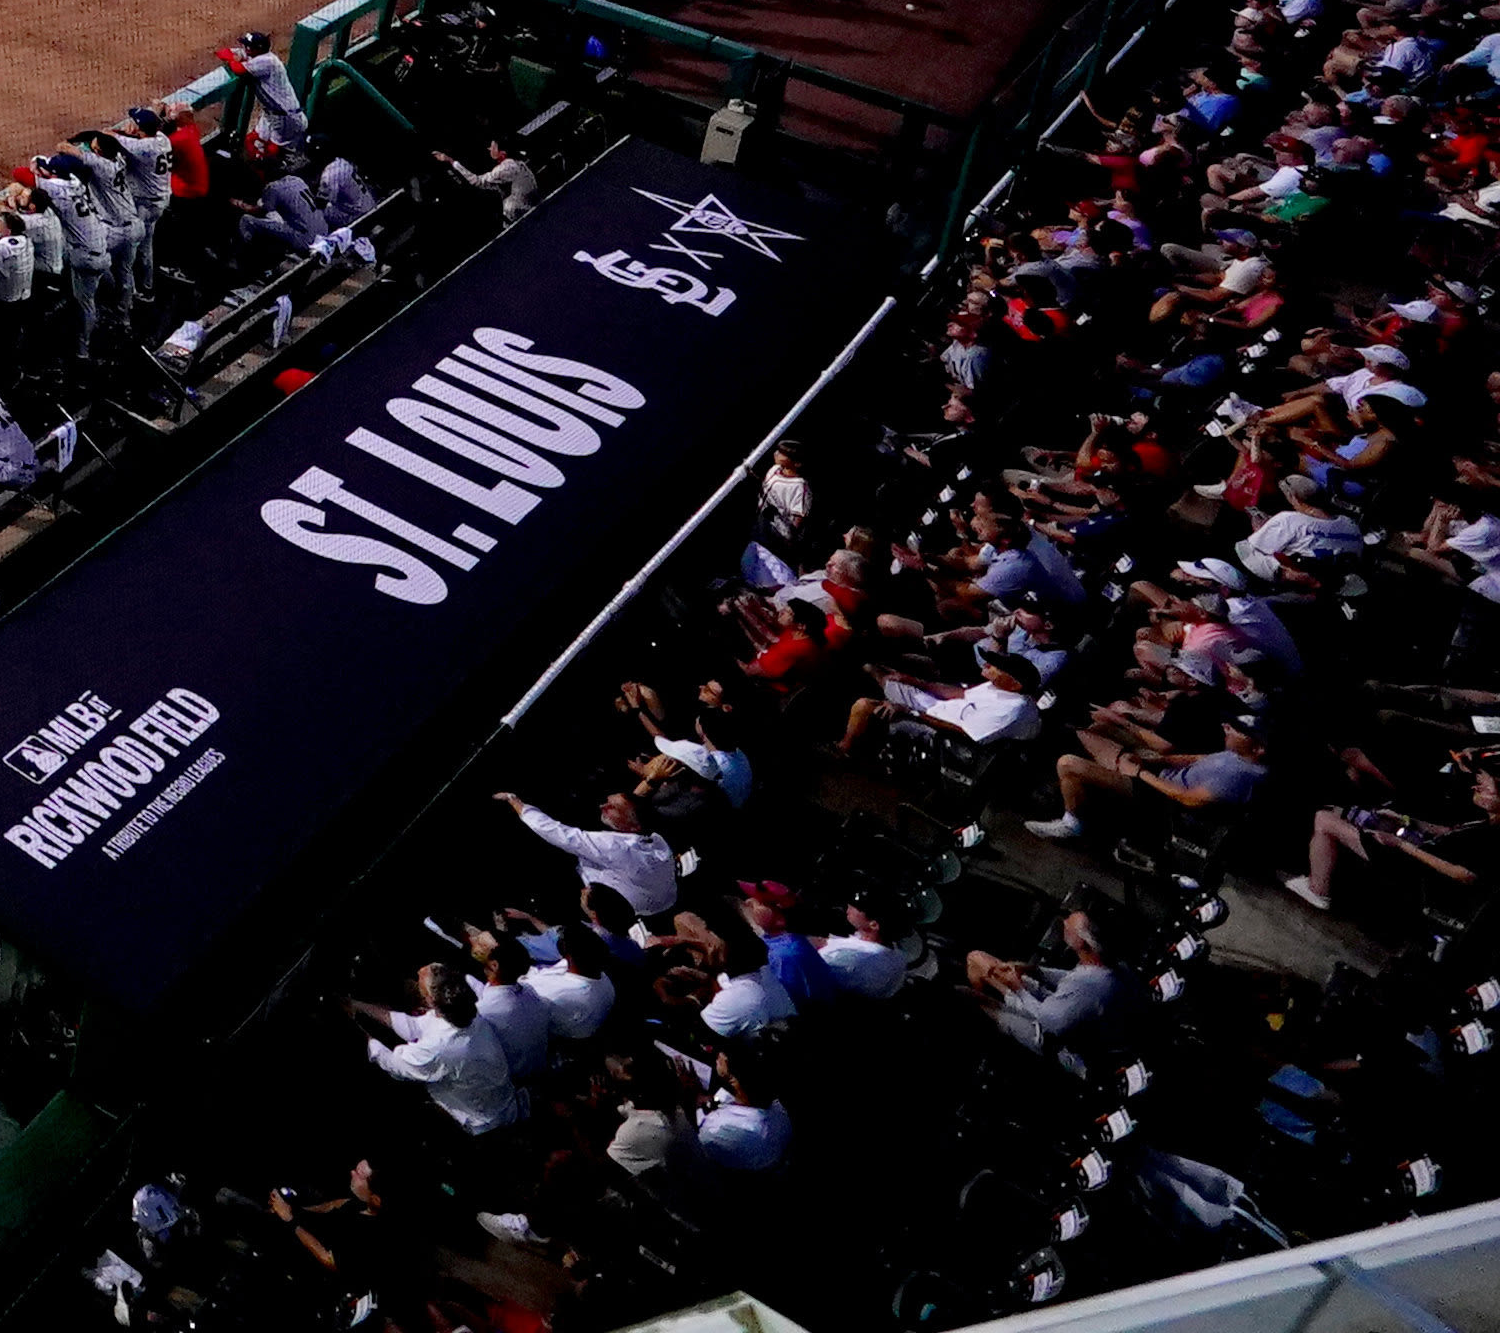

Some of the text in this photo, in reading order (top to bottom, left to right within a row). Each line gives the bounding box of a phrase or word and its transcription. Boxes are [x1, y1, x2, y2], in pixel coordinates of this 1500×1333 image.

[260, 327, 647, 605] ST. LOUIS
[3, 687, 221, 870] RICKWOOD FIELD
[38, 702, 108, 755] MLB
[101, 747, 227, 861] A TRIBUTE TO THE NEGRO LEAGUES
